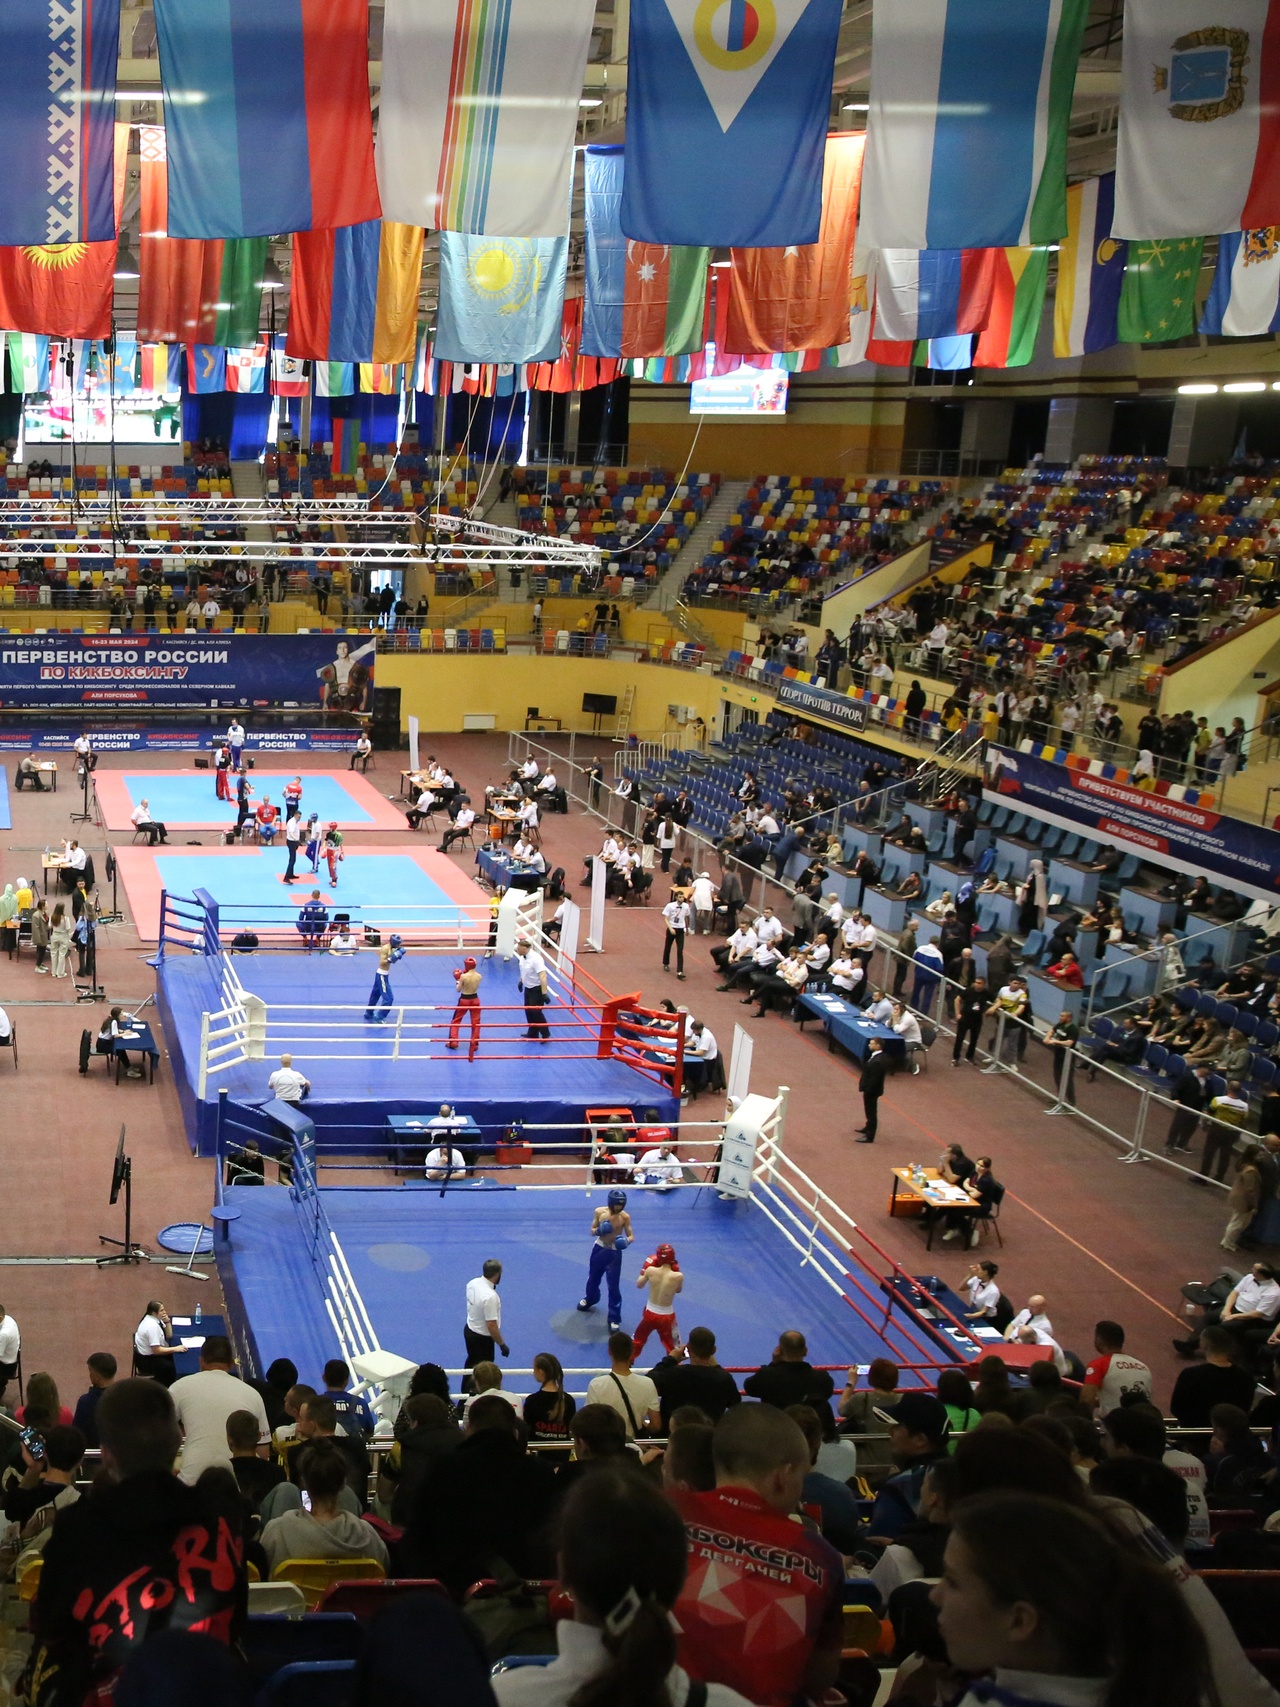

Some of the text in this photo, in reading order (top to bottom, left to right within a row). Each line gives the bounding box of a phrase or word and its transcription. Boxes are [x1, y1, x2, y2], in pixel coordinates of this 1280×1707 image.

[2, 650, 228, 664] ПЕРВЕНСТВО РОССИИ
[40, 666, 188, 680] ПО КИКБОКСИНГУ
[832, 702, 863, 723] ТЕРРОРА
[1078, 778, 1205, 825] ПРИВЕТСТВУЕМ УЧАСТНИКОВ
[699, 1548, 791, 1584] ДЕРГАЧЕЙ
